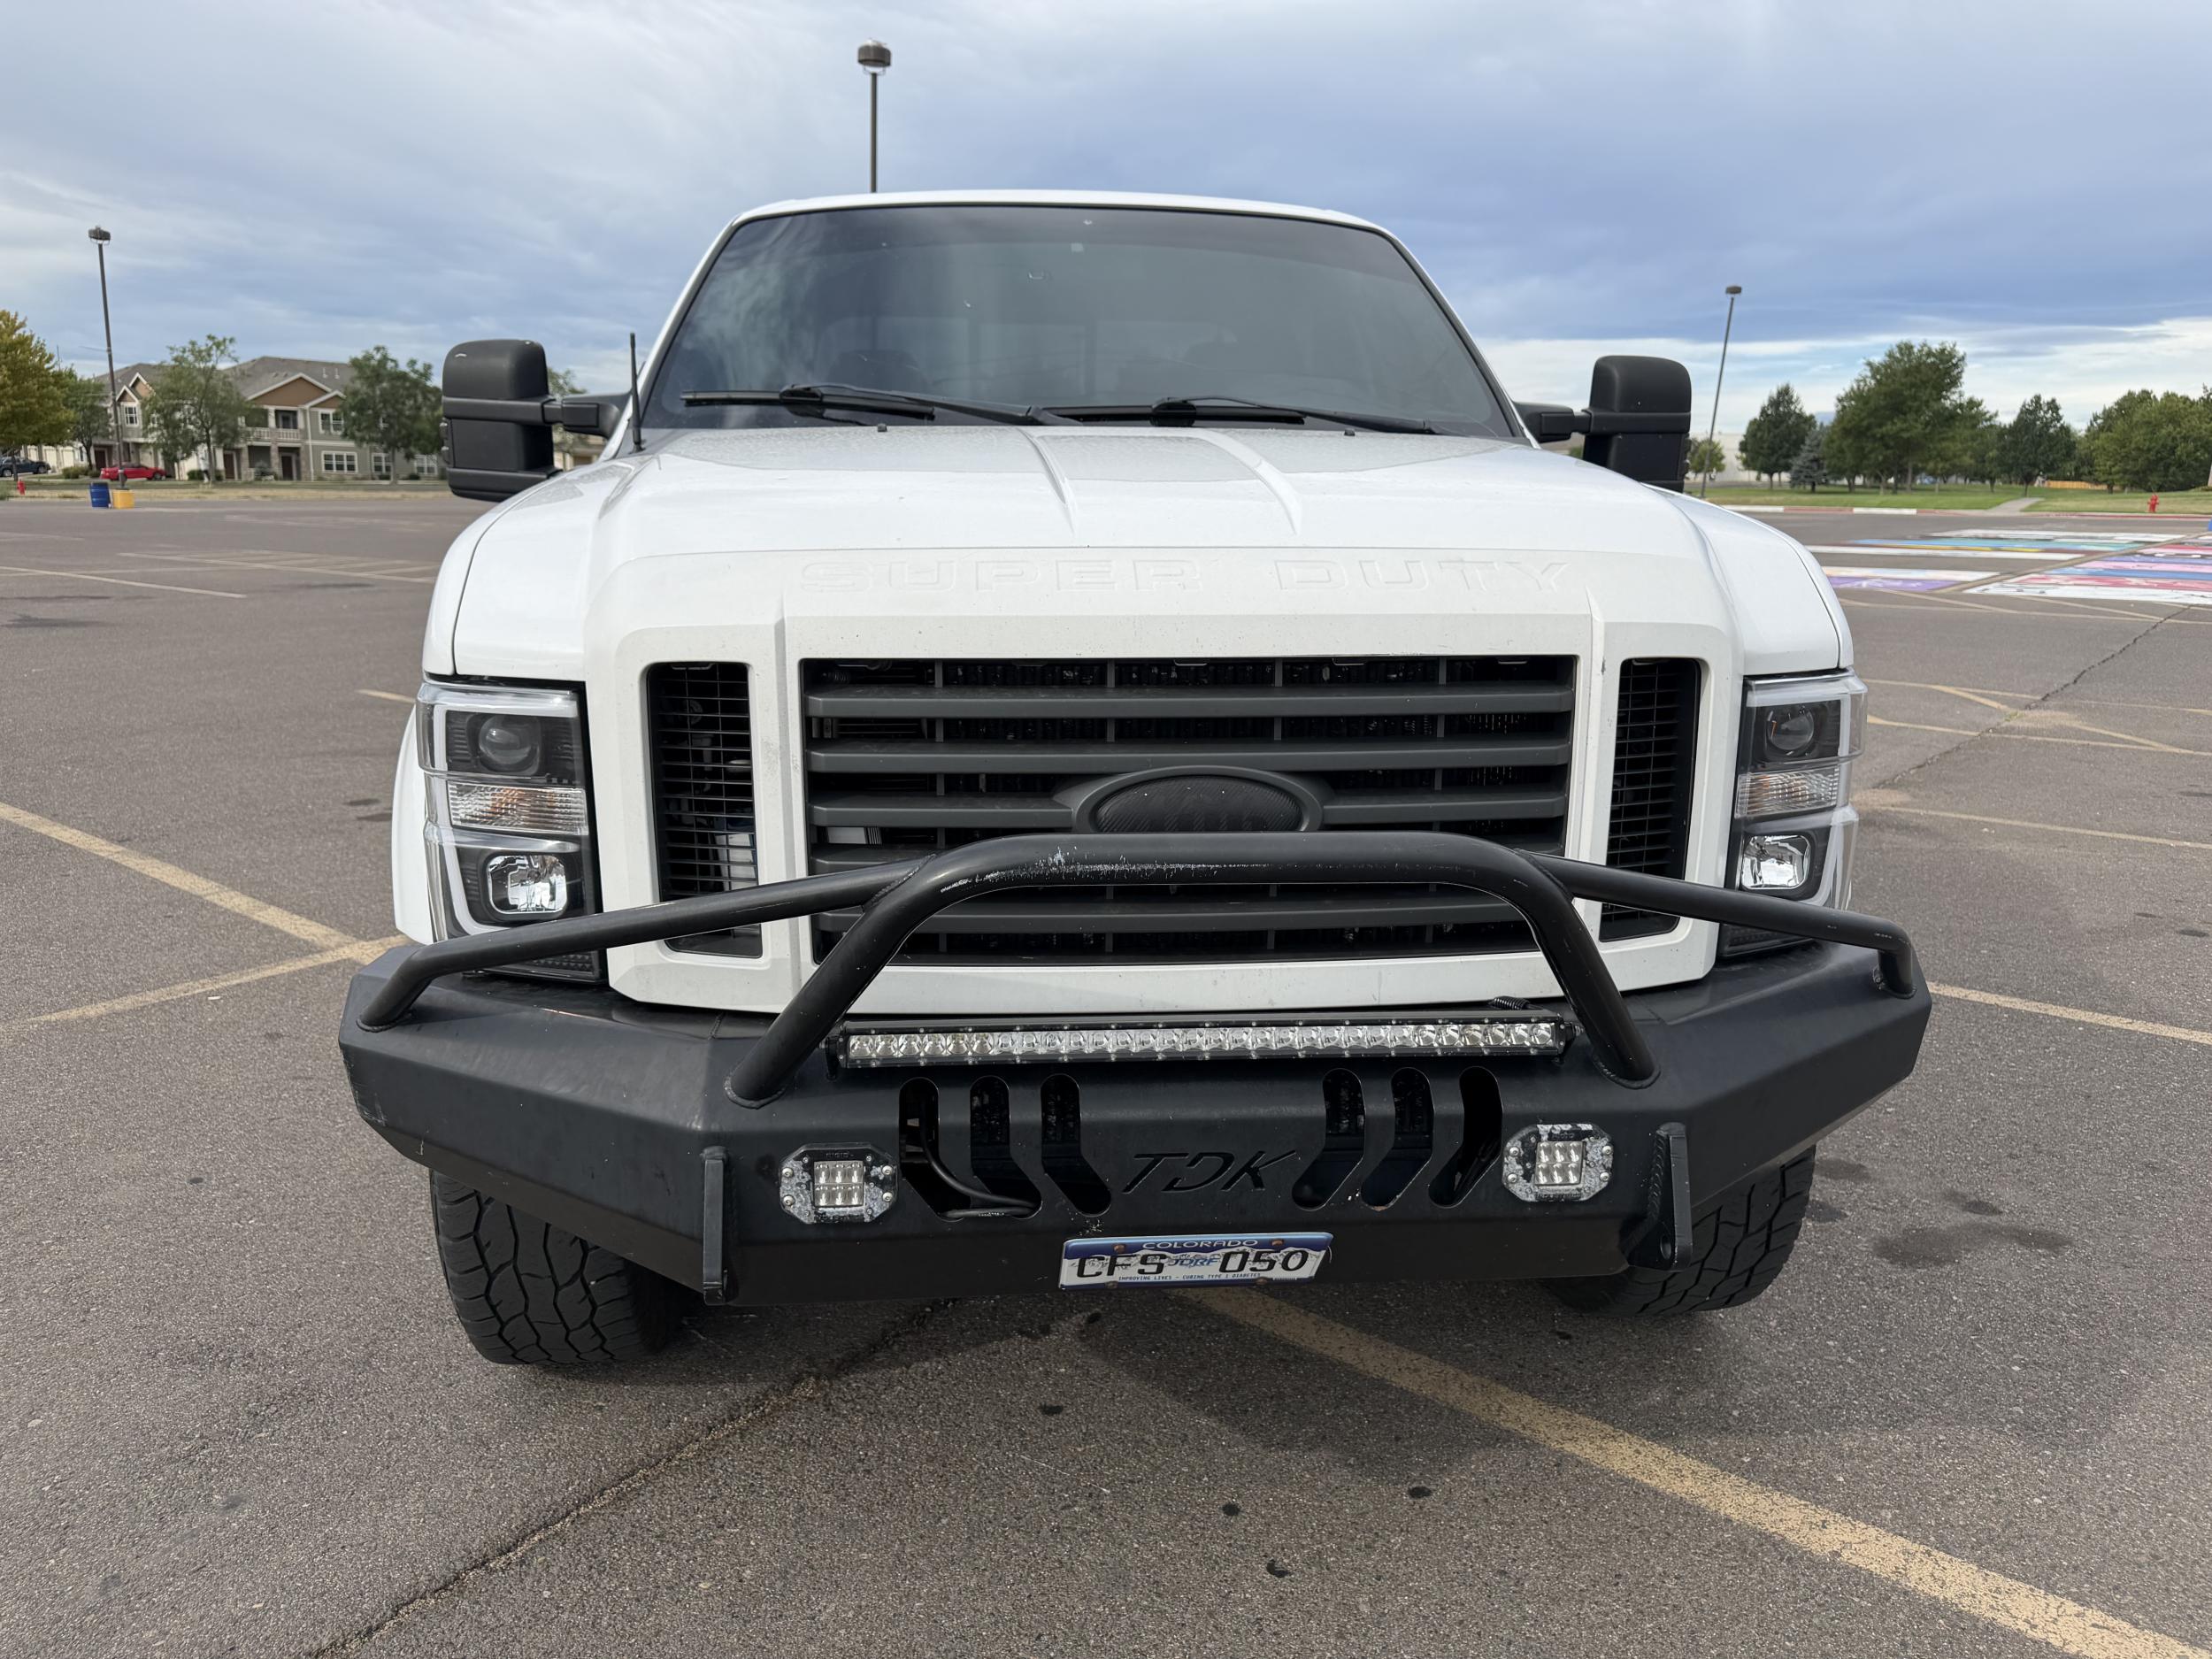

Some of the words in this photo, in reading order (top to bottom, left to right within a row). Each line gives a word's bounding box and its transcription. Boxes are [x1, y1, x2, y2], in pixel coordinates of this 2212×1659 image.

[801, 559, 1203, 594] SUPER
[1274, 560, 1569, 592] DUTY
[1121, 1150, 1297, 1194] TDK
[1142, 1239, 1259, 1250] COLORADO
[1076, 1253, 1168, 1279] CFS
